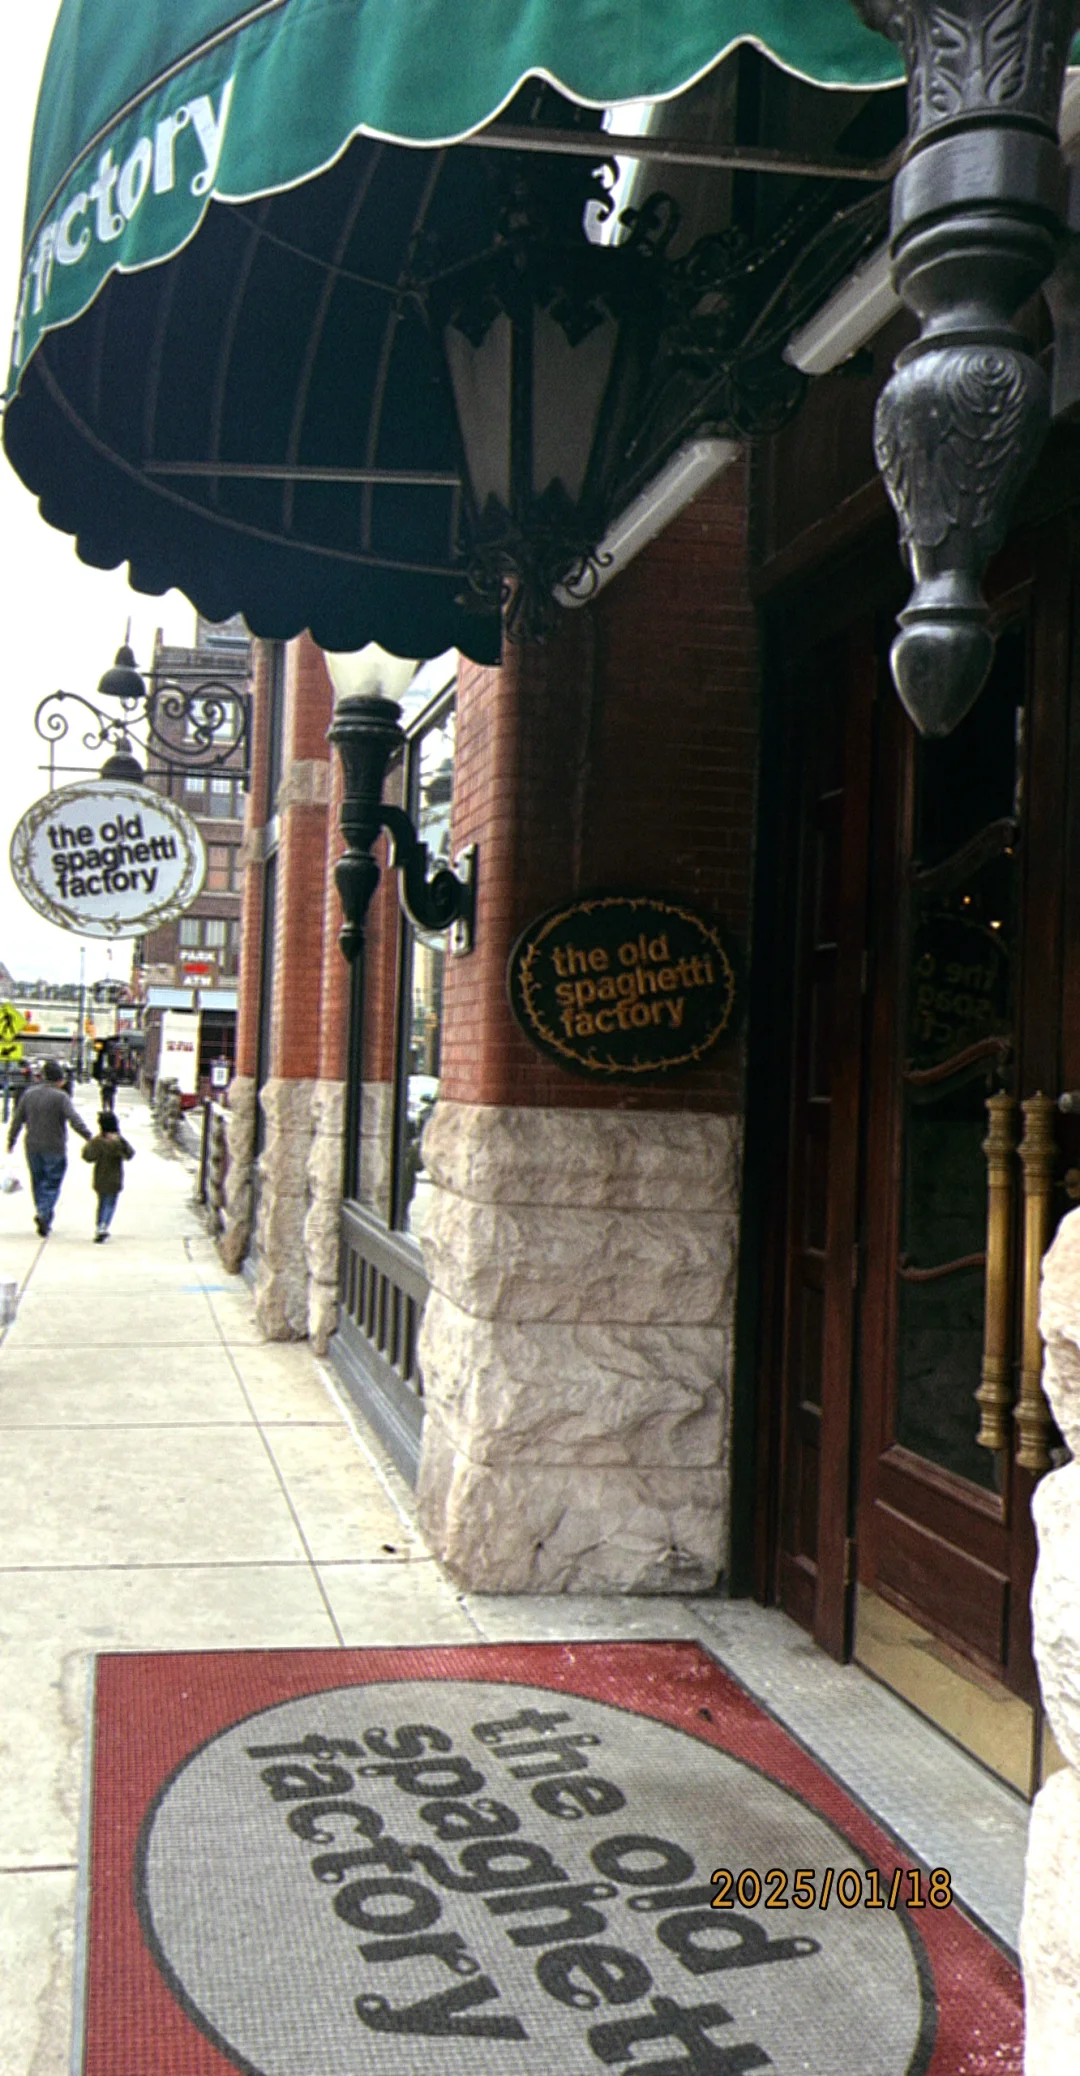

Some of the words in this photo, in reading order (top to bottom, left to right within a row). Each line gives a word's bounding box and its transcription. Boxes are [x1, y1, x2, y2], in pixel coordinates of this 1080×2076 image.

[46, 823, 94, 850] the
[99, 813, 144, 843] old
[51, 835, 177, 876] spaghetti
[55, 867, 158, 899] factory
[552, 944, 609, 977] the
[617, 932, 670, 967] old
[555, 954, 714, 1010] spaghetti
[560, 997, 688, 1039] factory
[472, 1707, 628, 1820] the
[590, 1834, 822, 1976] old
[245, 1733, 527, 2042] factory
[357, 1723, 773, 2076] spaghett
